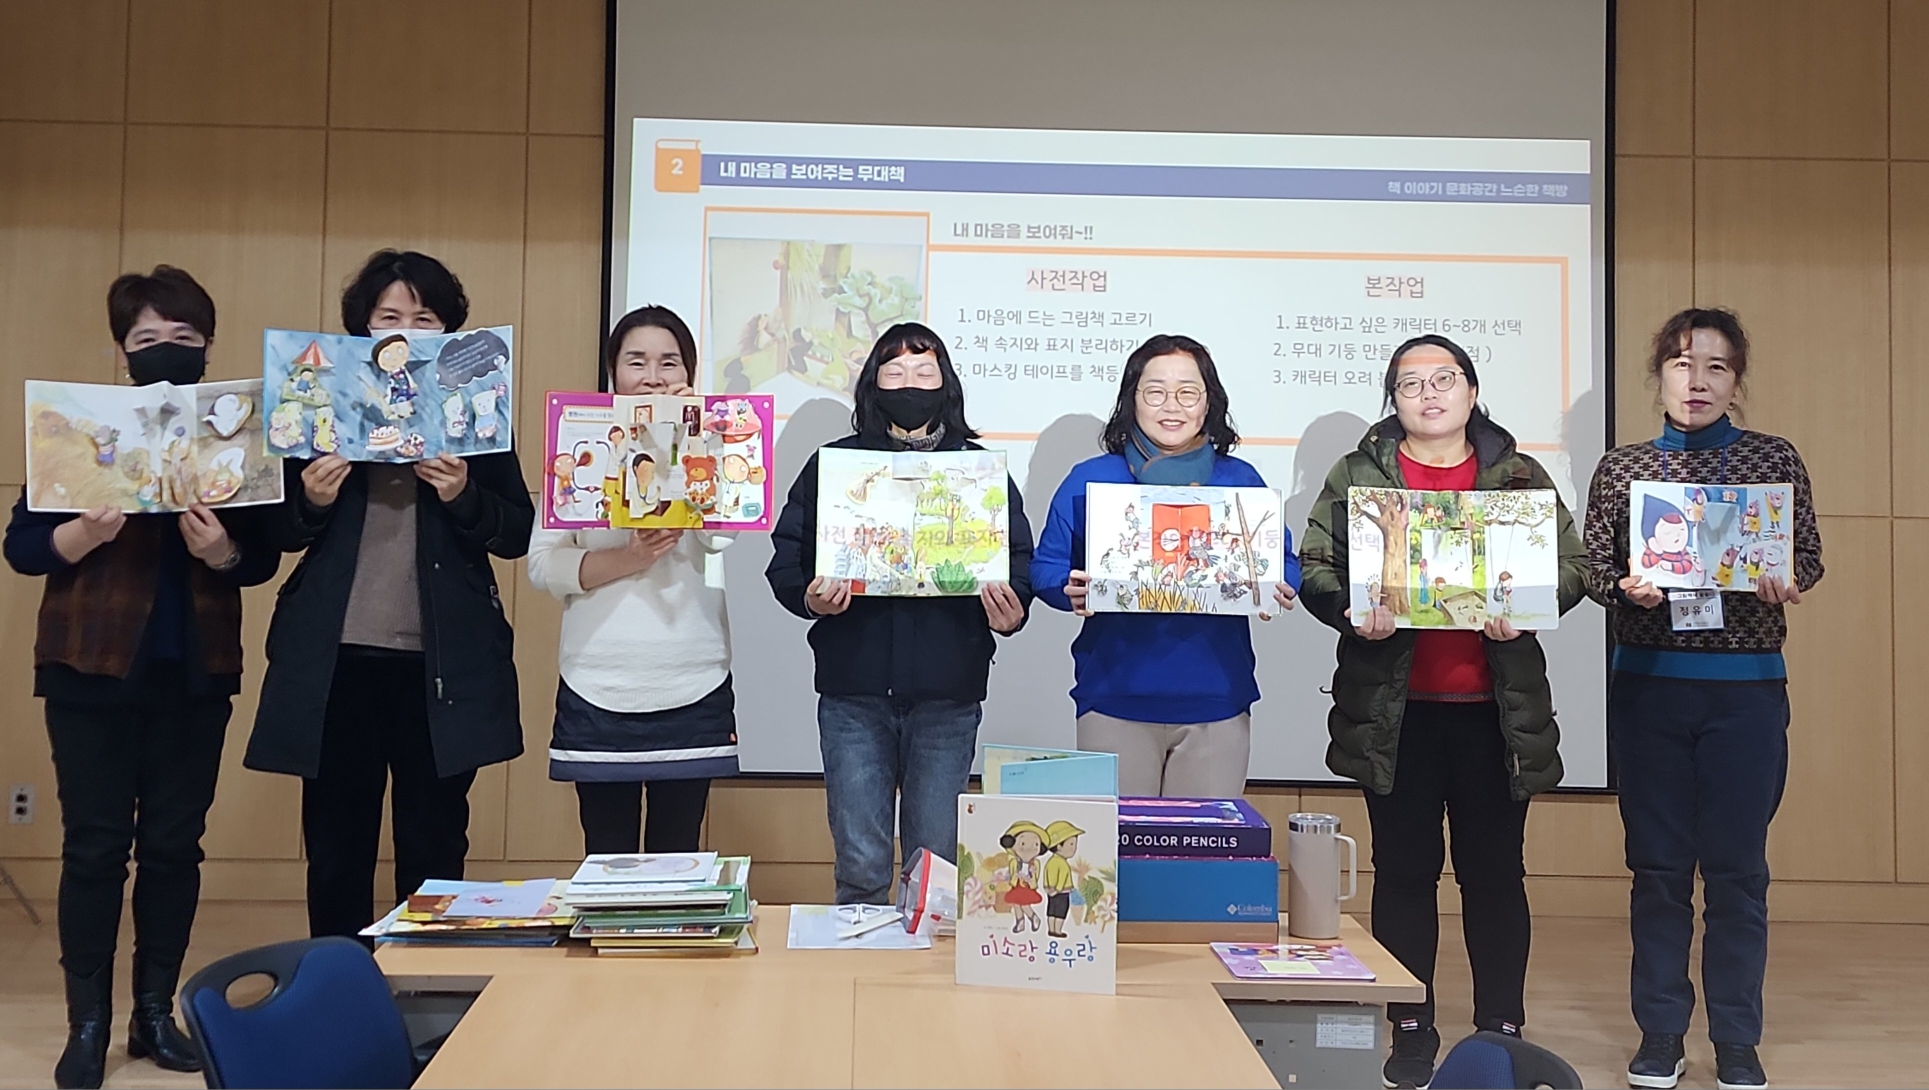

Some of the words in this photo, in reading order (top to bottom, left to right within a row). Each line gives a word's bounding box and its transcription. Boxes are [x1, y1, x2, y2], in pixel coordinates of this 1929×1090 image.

[671, 158, 683, 175] 2
[719, 161, 735, 178] 내
[740, 162, 787, 180] 마음을
[791, 163, 854, 181] 보여주는
[857, 165, 905, 183] 무대책
[1387, 181, 1401, 194] 책
[1404, 181, 1442, 195] 이야기
[1446, 182, 1498, 196] 문화공간
[1501, 183, 1539, 197] 느슨한
[1542, 184, 1568, 198] 책방
[953, 222, 969, 238] 내
[973, 222, 1021, 240] 마음을
[1026, 224, 1094, 241] 보여줘~!!
[1027, 270, 1108, 293] 사전작업
[1365, 276, 1425, 299] 본작업
[957, 308, 972, 324] 1.
[976, 309, 1022, 326] 마음에
[1027, 310, 1056, 326] 드는
[1060, 310, 1105, 327] 그림책
[1109, 311, 1153, 328] 고르기
[1276, 314, 1290, 330] 1.
[1294, 315, 1354, 332] 표현하고
[1359, 316, 1388, 334] 싶은
[1393, 316, 1438, 334] 캐릭터
[1442, 318, 1487, 334] 6~8개
[1492, 319, 1523, 336] 선택
[954, 336, 968, 350] 2.
[973, 335, 988, 352] 책
[994, 336, 1039, 353] 속지와
[1045, 337, 1075, 353] 표지
[1273, 342, 1287, 357] 2.
[1291, 342, 1322, 359] 무대
[1328, 343, 1357, 361] 기둥
[1362, 343, 1393, 361] 만들
[972, 362, 1018, 380] 마스킹
[1023, 363, 1084, 382] 테이프를
[1273, 369, 1287, 384] 3.
[1292, 369, 1337, 387] 캐릭터
[1343, 370, 1373, 387] 오려
[1134, 835, 1178, 847] COLOR
[1183, 836, 1238, 848] PENCILS
[981, 934, 1038, 963] 미소랑
[1045, 934, 1098, 969] 용우랑
